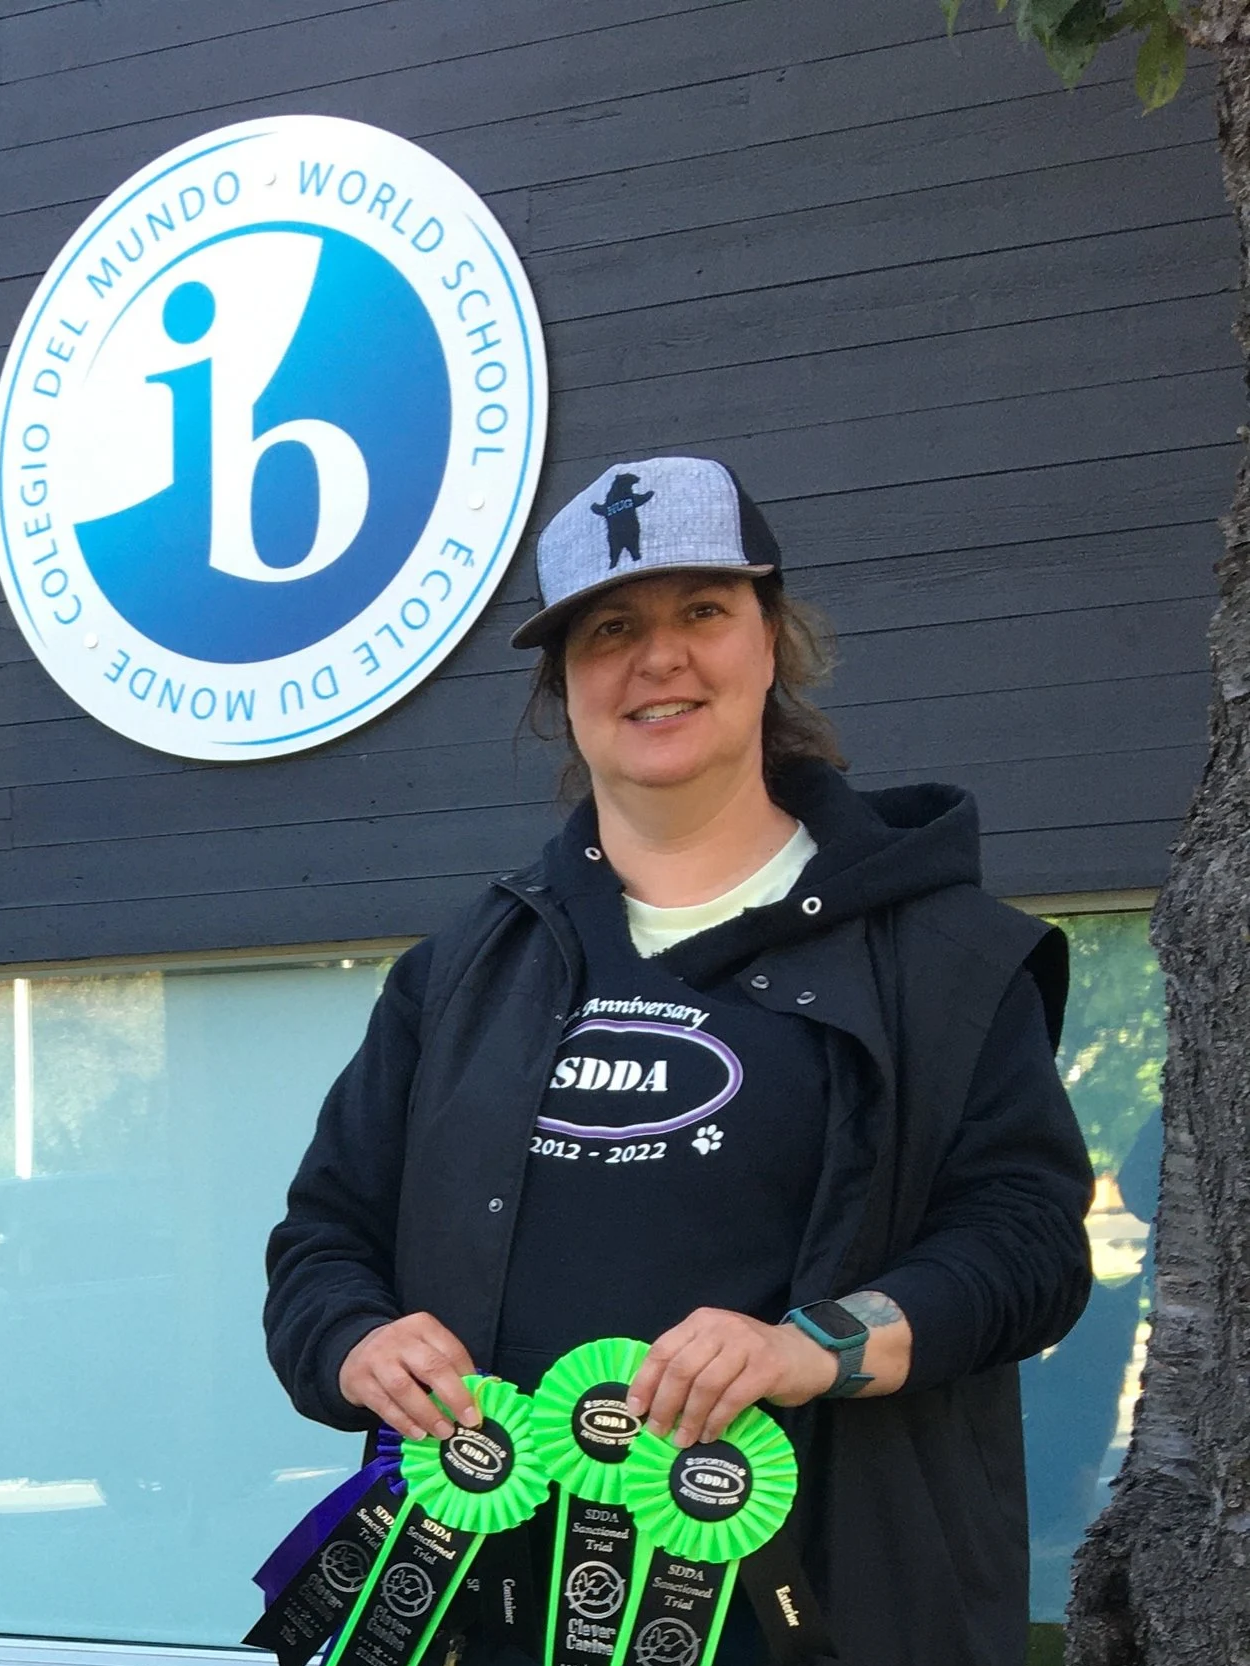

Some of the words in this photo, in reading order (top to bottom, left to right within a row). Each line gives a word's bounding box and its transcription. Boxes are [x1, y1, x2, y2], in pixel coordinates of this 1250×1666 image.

[86, 170, 241, 300] MUNDO
[298, 160, 446, 254] WORLD
[441, 259, 510, 467] SCHOOL
[32, 318, 89, 399] DEL
[145, 281, 370, 583] ib
[20, 422, 83, 626] COLEGIO
[352, 536, 476, 677] ÉCOLE
[104, 648, 255, 722] MONDE
[280, 664, 340, 715] DU
[581, 995, 711, 1032] Anniversary
[549, 1056, 669, 1092] SDDA
[529, 1136, 582, 1160] 2012
[604, 1141, 668, 1164] 2022
[593, 1414, 627, 1430] SDDA
[459, 1443, 490, 1466] SDDA
[694, 1472, 730, 1489] SDDA
[372, 1504, 396, 1529] SDD
[420, 1518, 452, 1543] SDDA
[584, 1508, 620, 1523] SDDA
[405, 1525, 457, 1560] Sanctioned
[571, 1522, 631, 1540] Sanctioned
[584, 1539, 614, 1553] Trial
[412, 1544, 439, 1565] Trial
[667, 1563, 705, 1582] SDDA
[502, 1578, 517, 1625] Container
[651, 1576, 714, 1600] Sanctioned
[663, 1594, 695, 1611] Trial
[373, 1604, 412, 1637] Clever
[775, 1584, 800, 1627] Exterior
[568, 1617, 617, 1639] Clever
